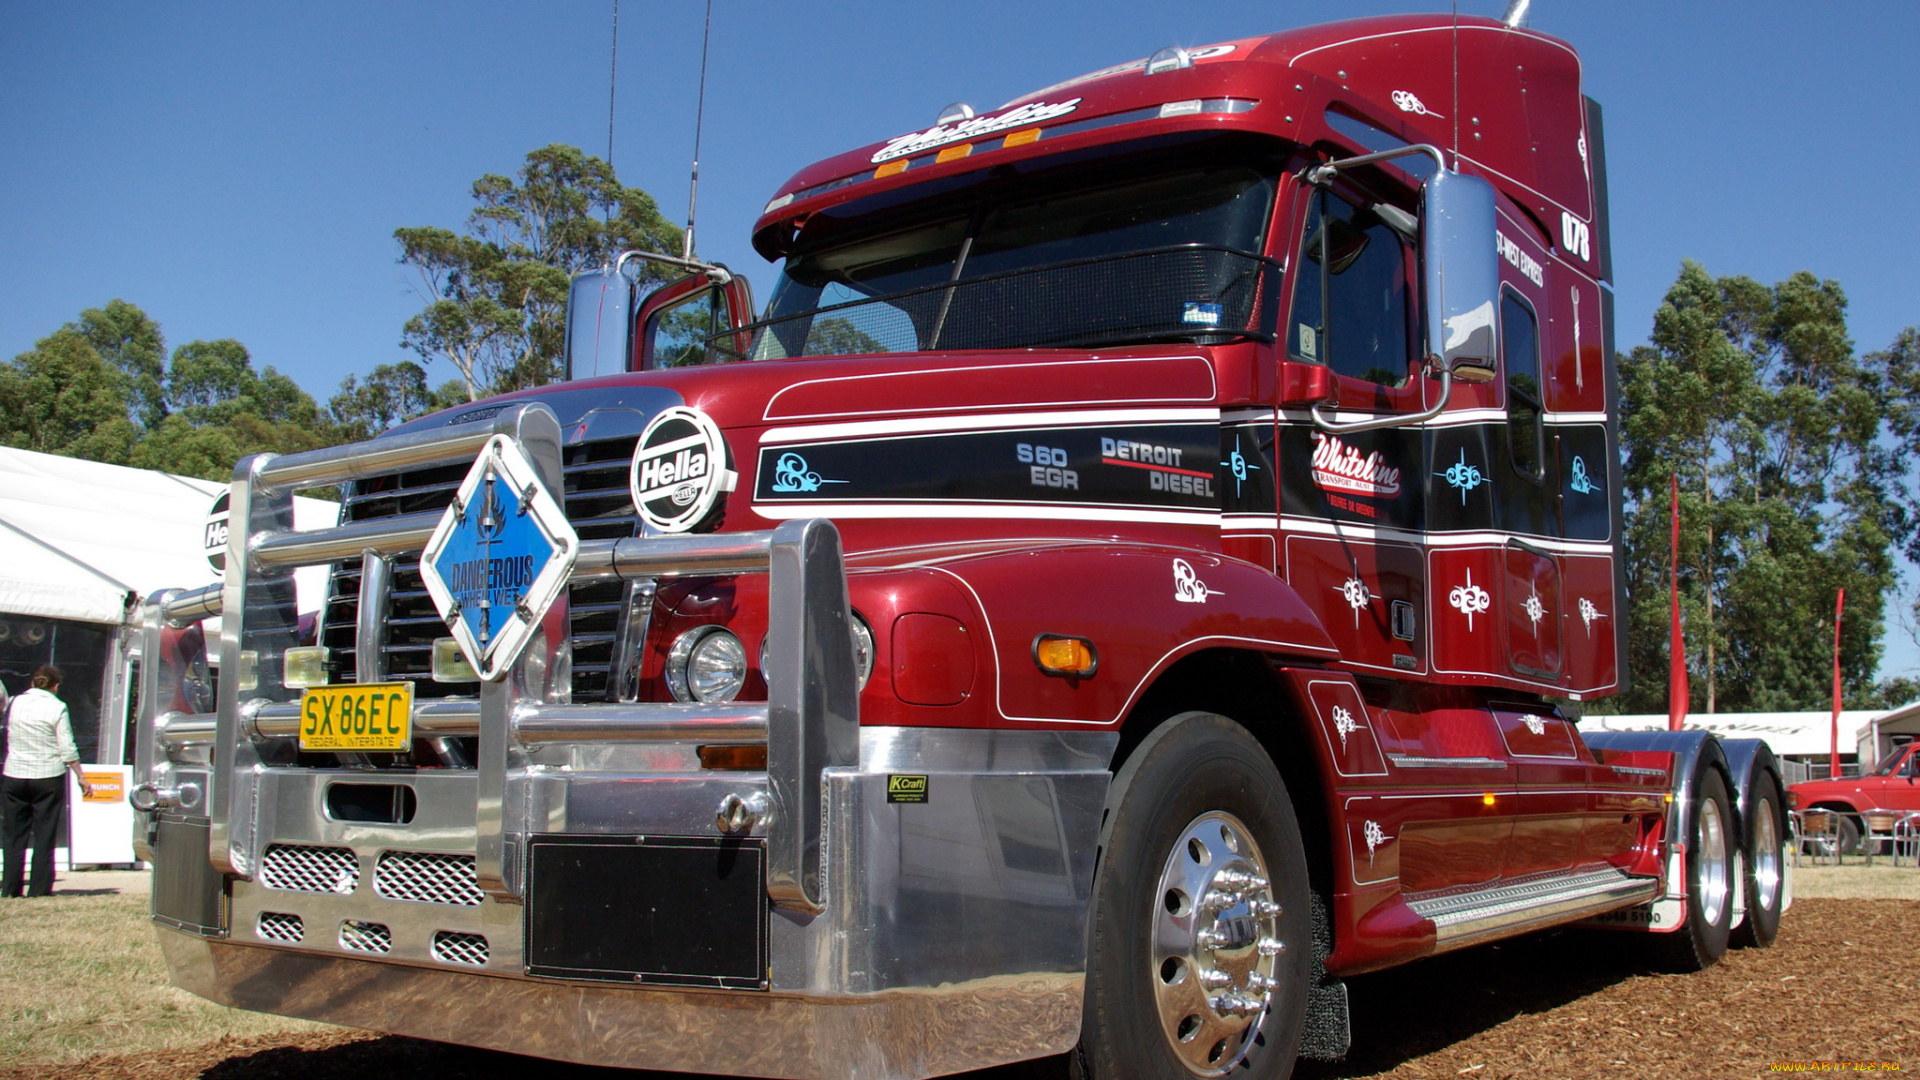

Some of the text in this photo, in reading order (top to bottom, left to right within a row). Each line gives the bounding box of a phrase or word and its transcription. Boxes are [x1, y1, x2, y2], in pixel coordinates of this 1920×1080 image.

[1562, 211, 1590, 263] 078
[1520, 250, 1543, 288] EXPRESS
[1016, 443, 1068, 468] S60
[1100, 437, 1182, 467] DETROIT
[1310, 430, 1400, 488] Whiteline
[640, 449, 707, 491] Hella
[1030, 465, 1079, 490] EGR
[1315, 471, 1352, 487] TRANSPORT
[1150, 471, 1214, 497] DIESEL
[452, 554, 534, 593] DANGEROUS
[493, 587, 519, 606] WET
[309, 736, 394, 747] FEDERAL INTERSTATE
[1631, 912, 1661, 923] 5100
